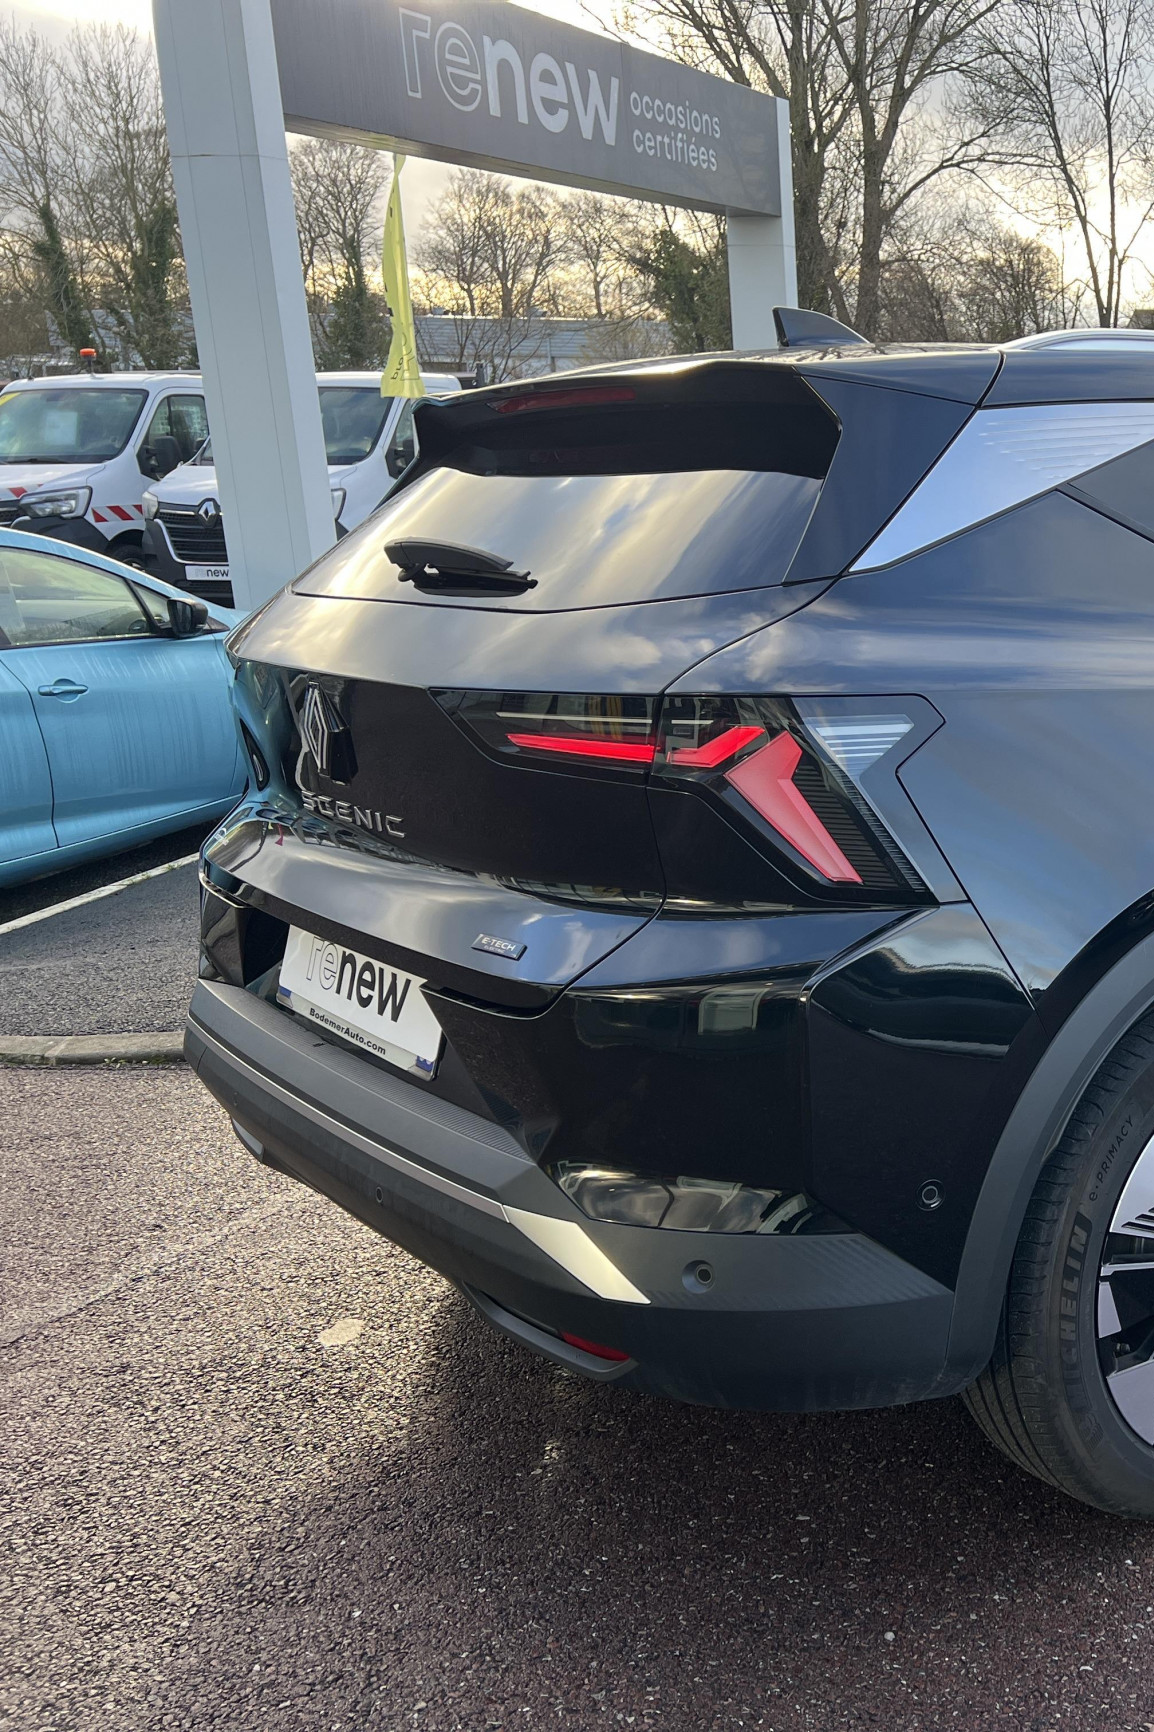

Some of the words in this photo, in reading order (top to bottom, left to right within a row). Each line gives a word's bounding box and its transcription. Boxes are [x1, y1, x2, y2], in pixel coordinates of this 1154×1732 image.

[399, 7, 620, 147] renew
[630, 90, 721, 140] occasions
[632, 129, 718, 172] certifiées
[301, 790, 405, 838] SCENIC
[481, 937, 516, 951] E-TECH
[305, 935, 412, 1023] renew
[309, 1006, 387, 1056] BodemerAuto.com
